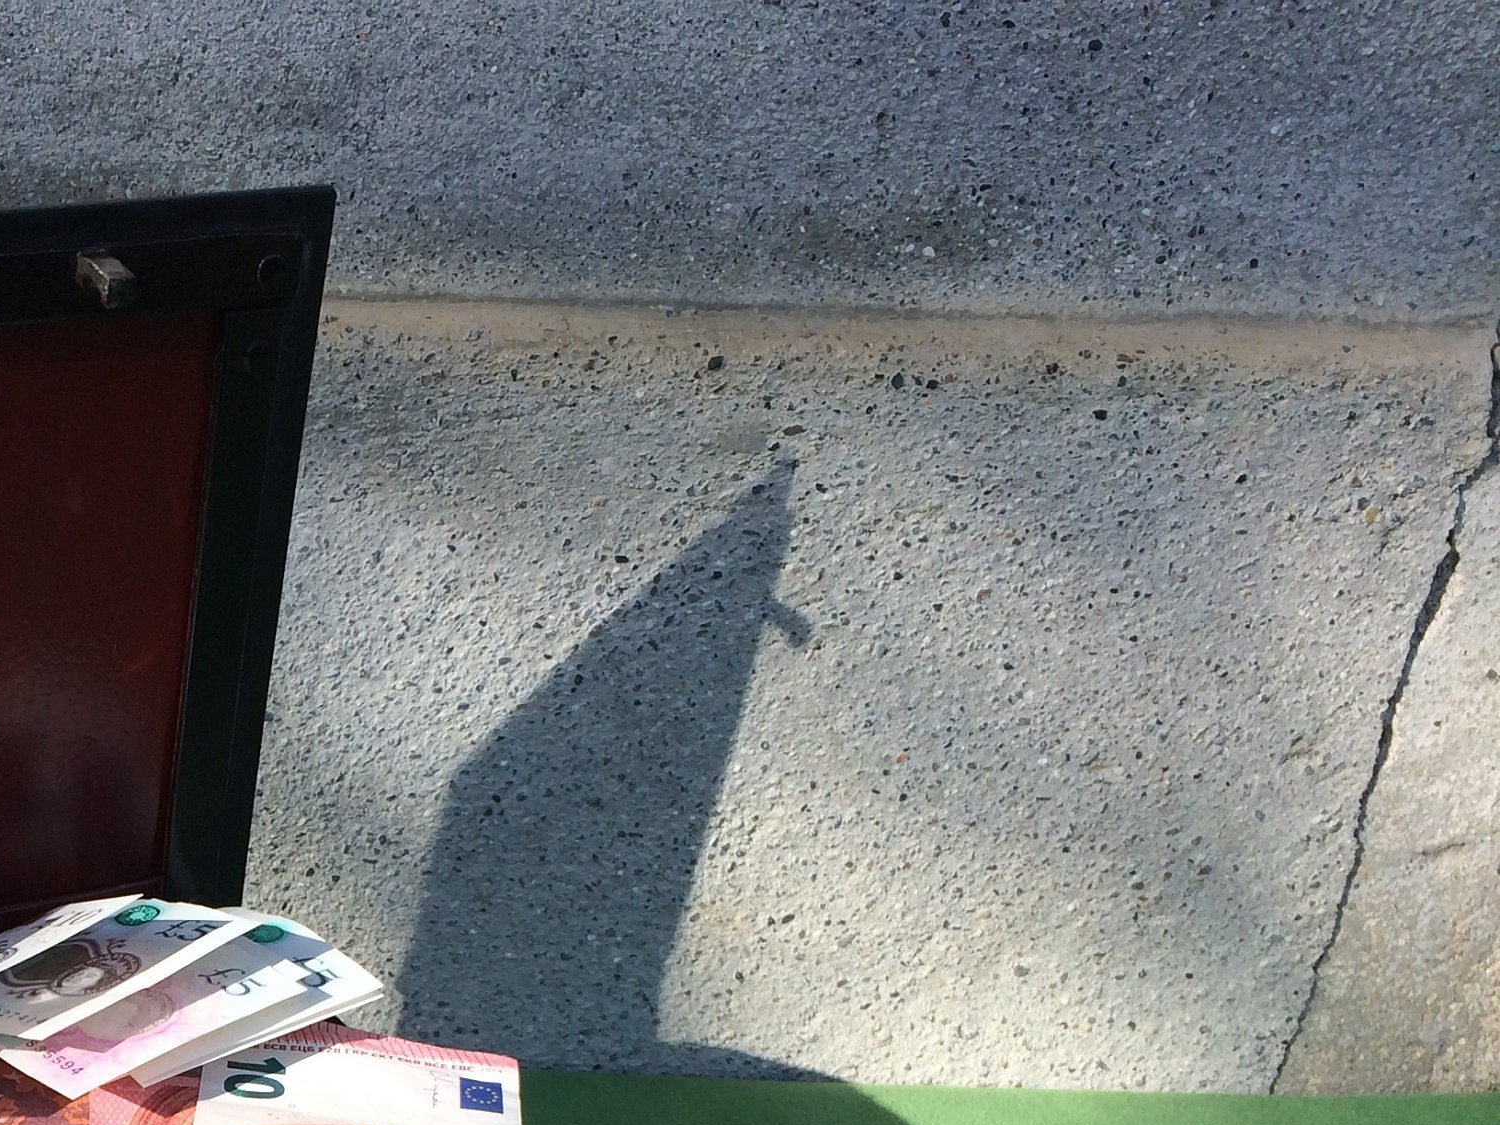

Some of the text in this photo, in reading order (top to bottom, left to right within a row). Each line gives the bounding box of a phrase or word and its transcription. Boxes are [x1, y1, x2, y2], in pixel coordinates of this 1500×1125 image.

[155, 920, 218, 941] £5
[198, 968, 268, 996] £5
[223, 1057, 286, 1099] 10
